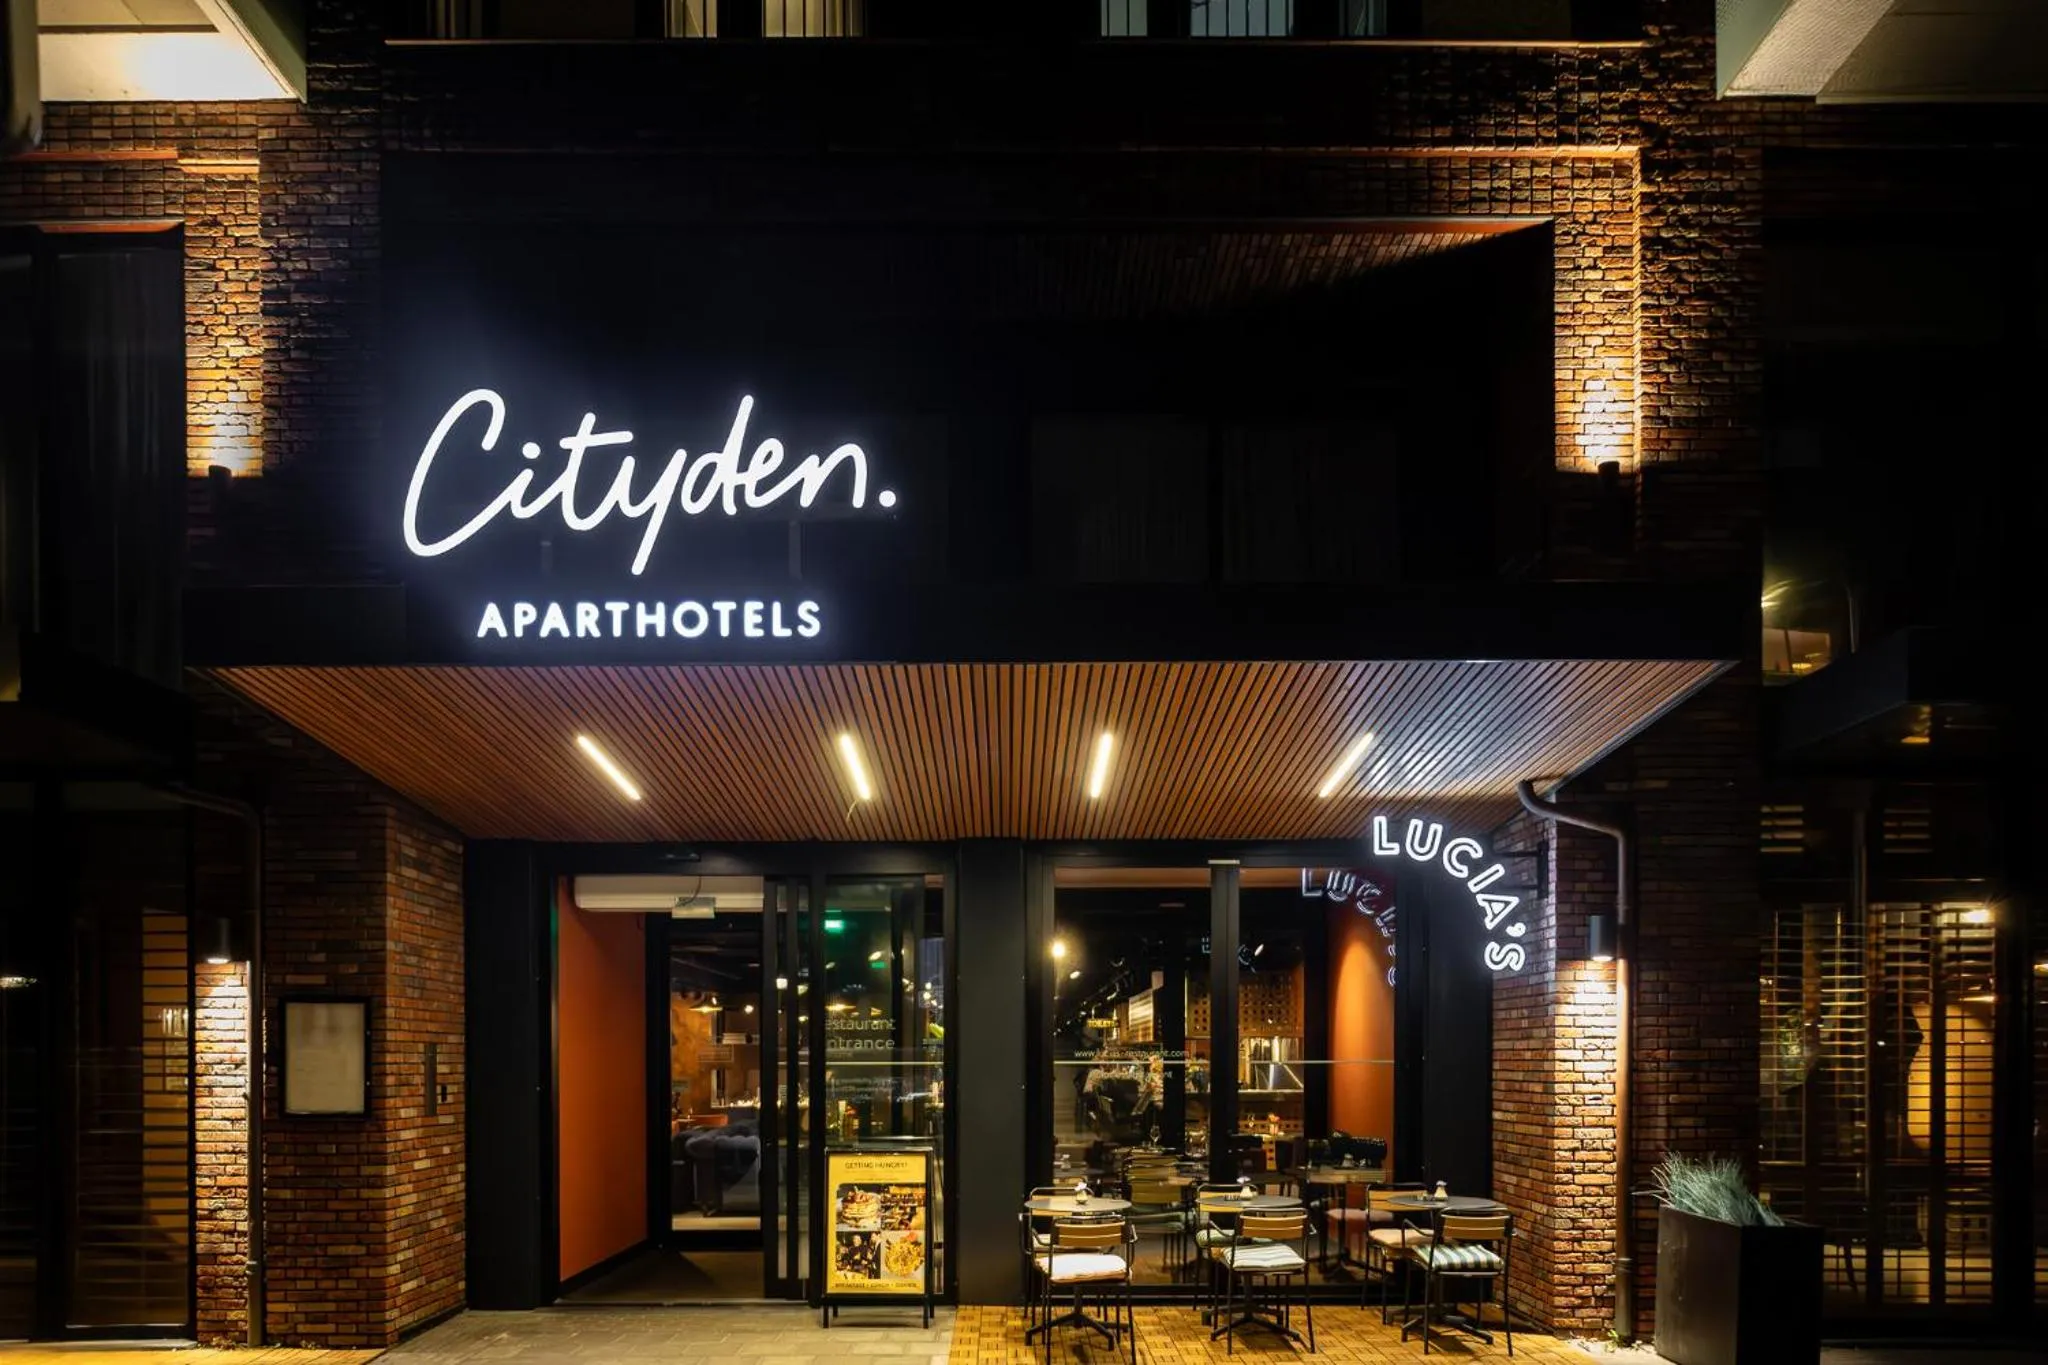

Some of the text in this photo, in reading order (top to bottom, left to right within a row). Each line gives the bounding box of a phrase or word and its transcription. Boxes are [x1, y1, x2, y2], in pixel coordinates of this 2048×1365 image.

[403, 389, 897, 575] Cityden.
[476, 600, 822, 638] APARTHOTELS
[1372, 815, 1526, 971] LUCIA'S
[825, 1018, 896, 1031] estaurant
[826, 1037, 896, 1050] ntrance
